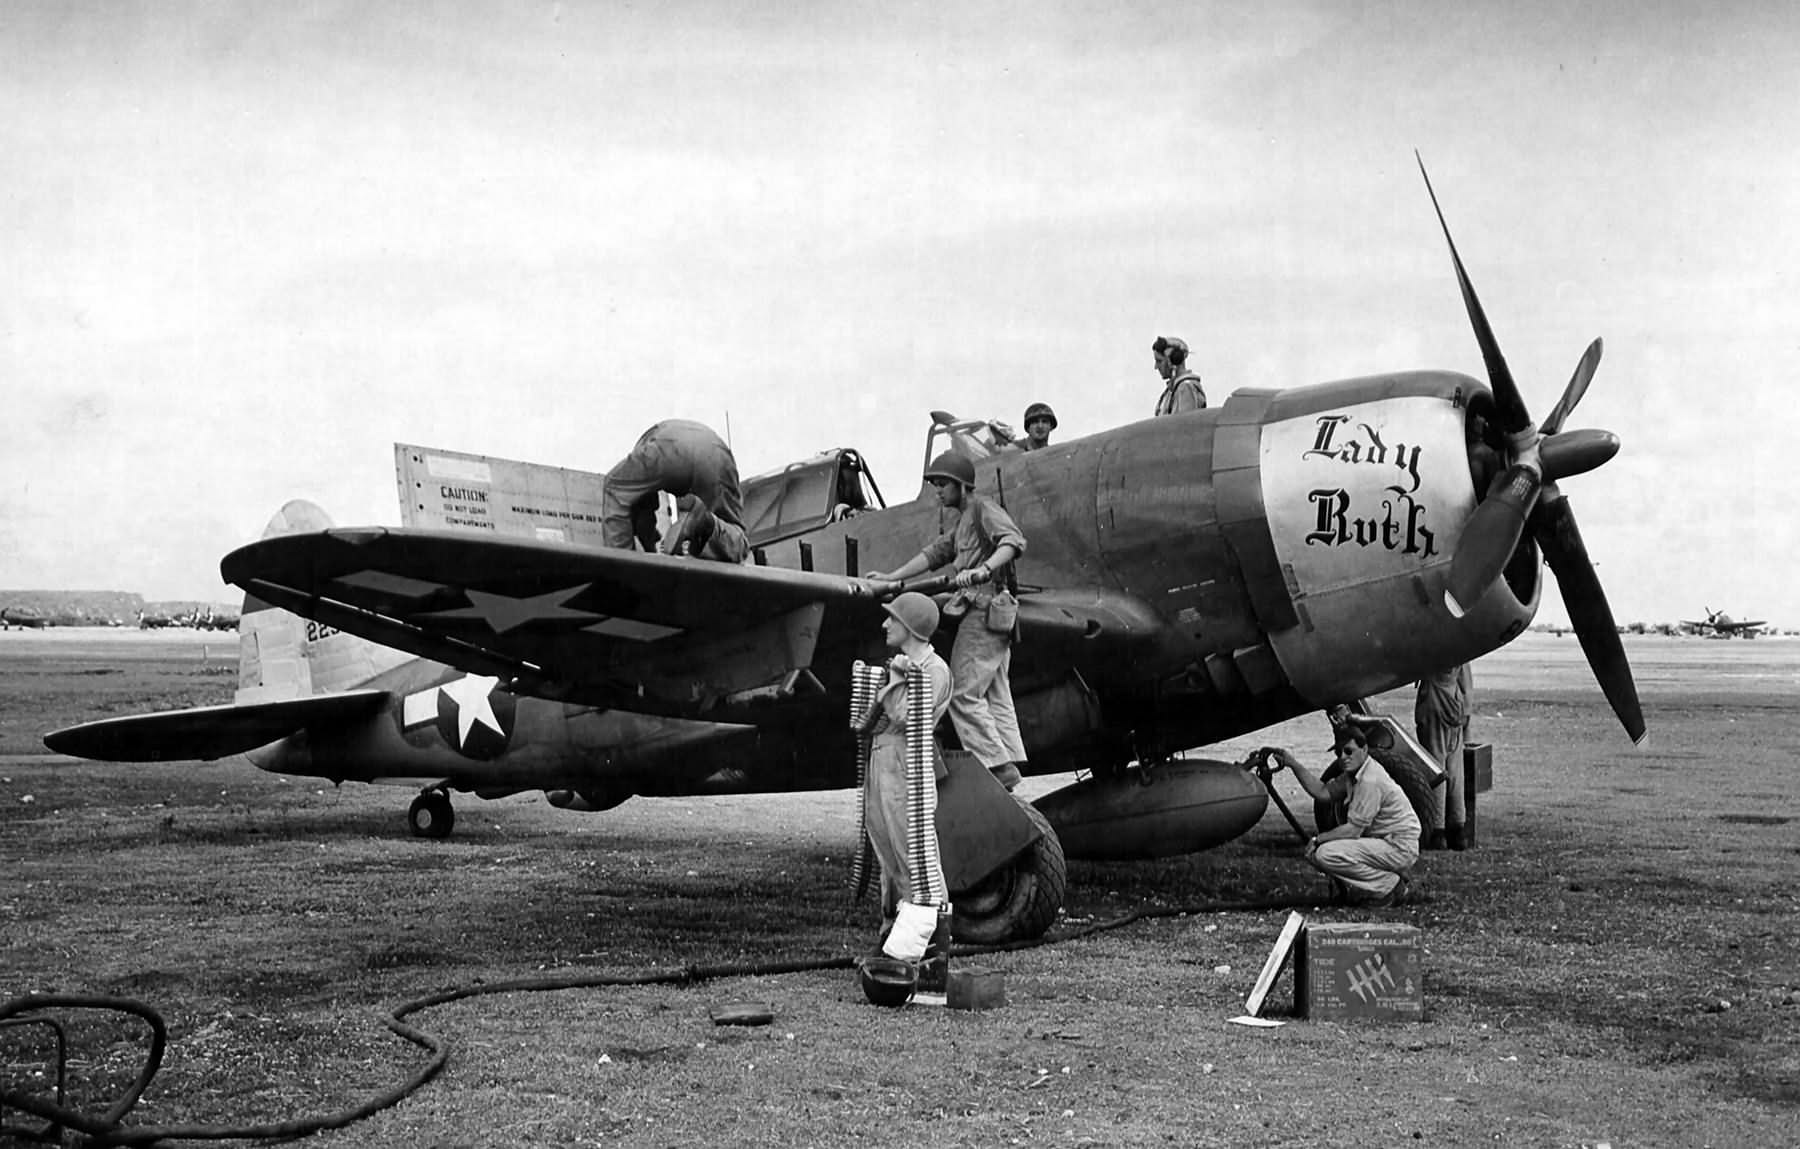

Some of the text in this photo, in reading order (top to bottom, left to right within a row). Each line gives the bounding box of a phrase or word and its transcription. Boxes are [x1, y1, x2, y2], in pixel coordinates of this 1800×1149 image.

[1302, 415, 1422, 494] Lady
[440, 486, 489, 502] CAUTION:
[1305, 487, 1439, 560] Ruth
